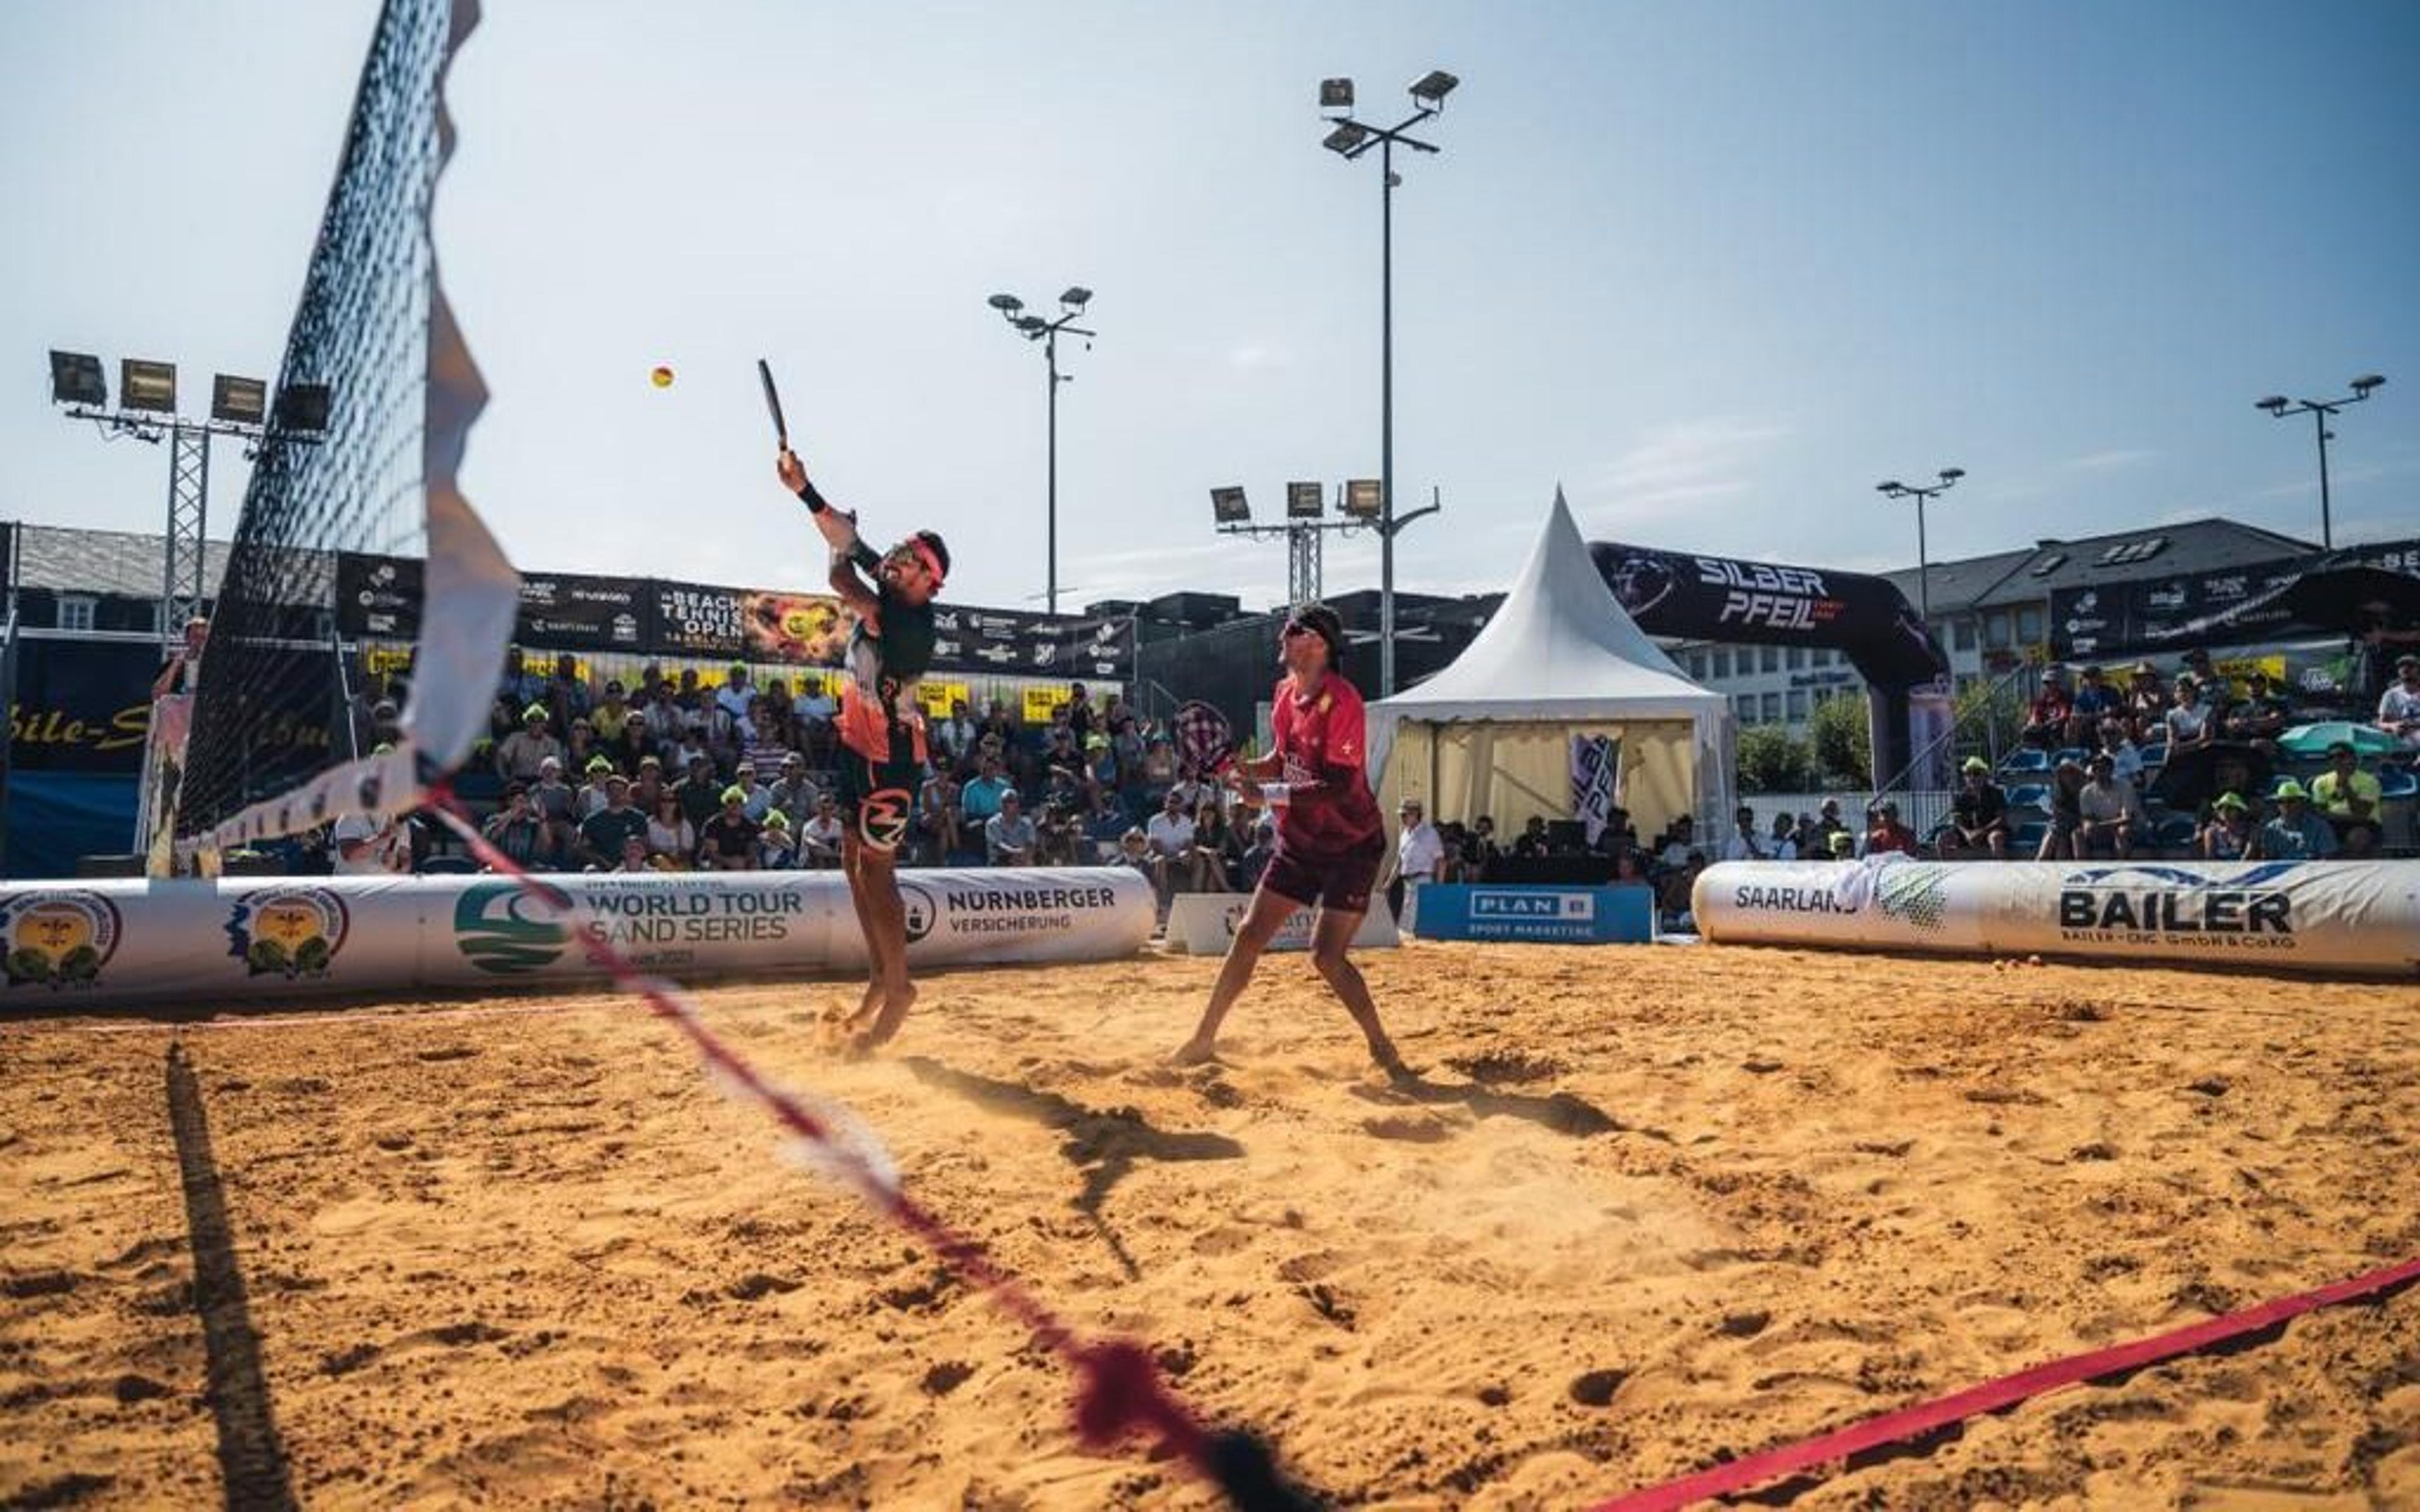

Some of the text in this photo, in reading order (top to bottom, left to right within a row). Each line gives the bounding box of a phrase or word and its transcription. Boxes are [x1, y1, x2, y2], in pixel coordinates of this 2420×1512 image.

[1695, 559, 1828, 597] SILBER
[673, 591, 742, 610] BEACH
[662, 604, 742, 624] TENNIS
[1720, 593, 1816, 629] PFEIL
[684, 620, 742, 637] OPEN
[586, 892, 803, 917] WORLD TOUR
[948, 887, 1115, 911] NÜRNBERGER
[1481, 898, 1551, 912] PLAN
[2060, 891, 2293, 934] BAILER
[589, 917, 787, 943] SAND SERIES
[950, 914, 1071, 932] VERSICHERUNG
[1470, 924, 1591, 937] SPORT MARKETING
[2165, 935, 2223, 946] GmbH
